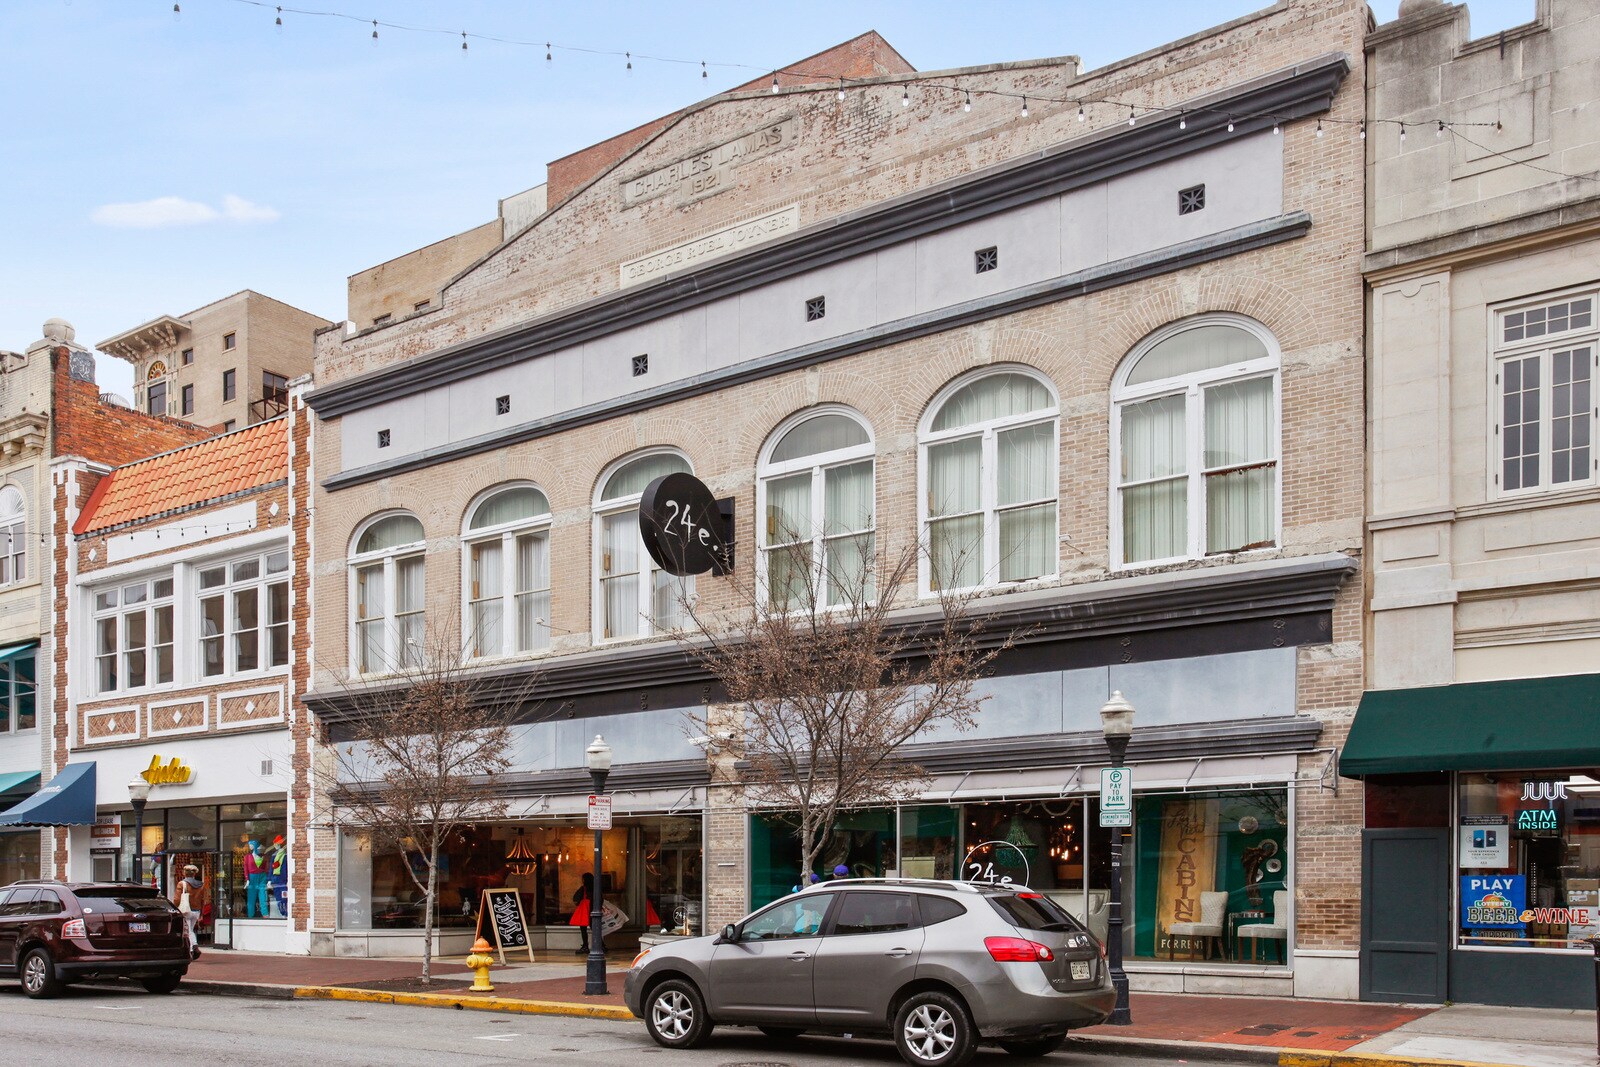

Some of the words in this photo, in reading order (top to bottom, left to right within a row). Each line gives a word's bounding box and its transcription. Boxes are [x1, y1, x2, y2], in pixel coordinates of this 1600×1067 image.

[633, 153, 713, 197] CHARLES
[719, 126, 783, 165] LAMAS
[690, 171, 721, 196] 1921
[627, 250, 684, 280] GEORGE
[686, 236, 724, 260] RUEL
[727, 214, 791, 247] JOYNER
[1520, 782, 1568, 801] JUUL
[1518, 809, 1557, 822] ATM
[1518, 821, 1558, 830] INSIDE
[1174, 837, 1197, 923] CABINS
[1471, 878, 1514, 890] PLAY
[1467, 907, 1518, 924] BEER
[1519, 909, 1536, 923] &
[1535, 907, 1589, 924] WINE
